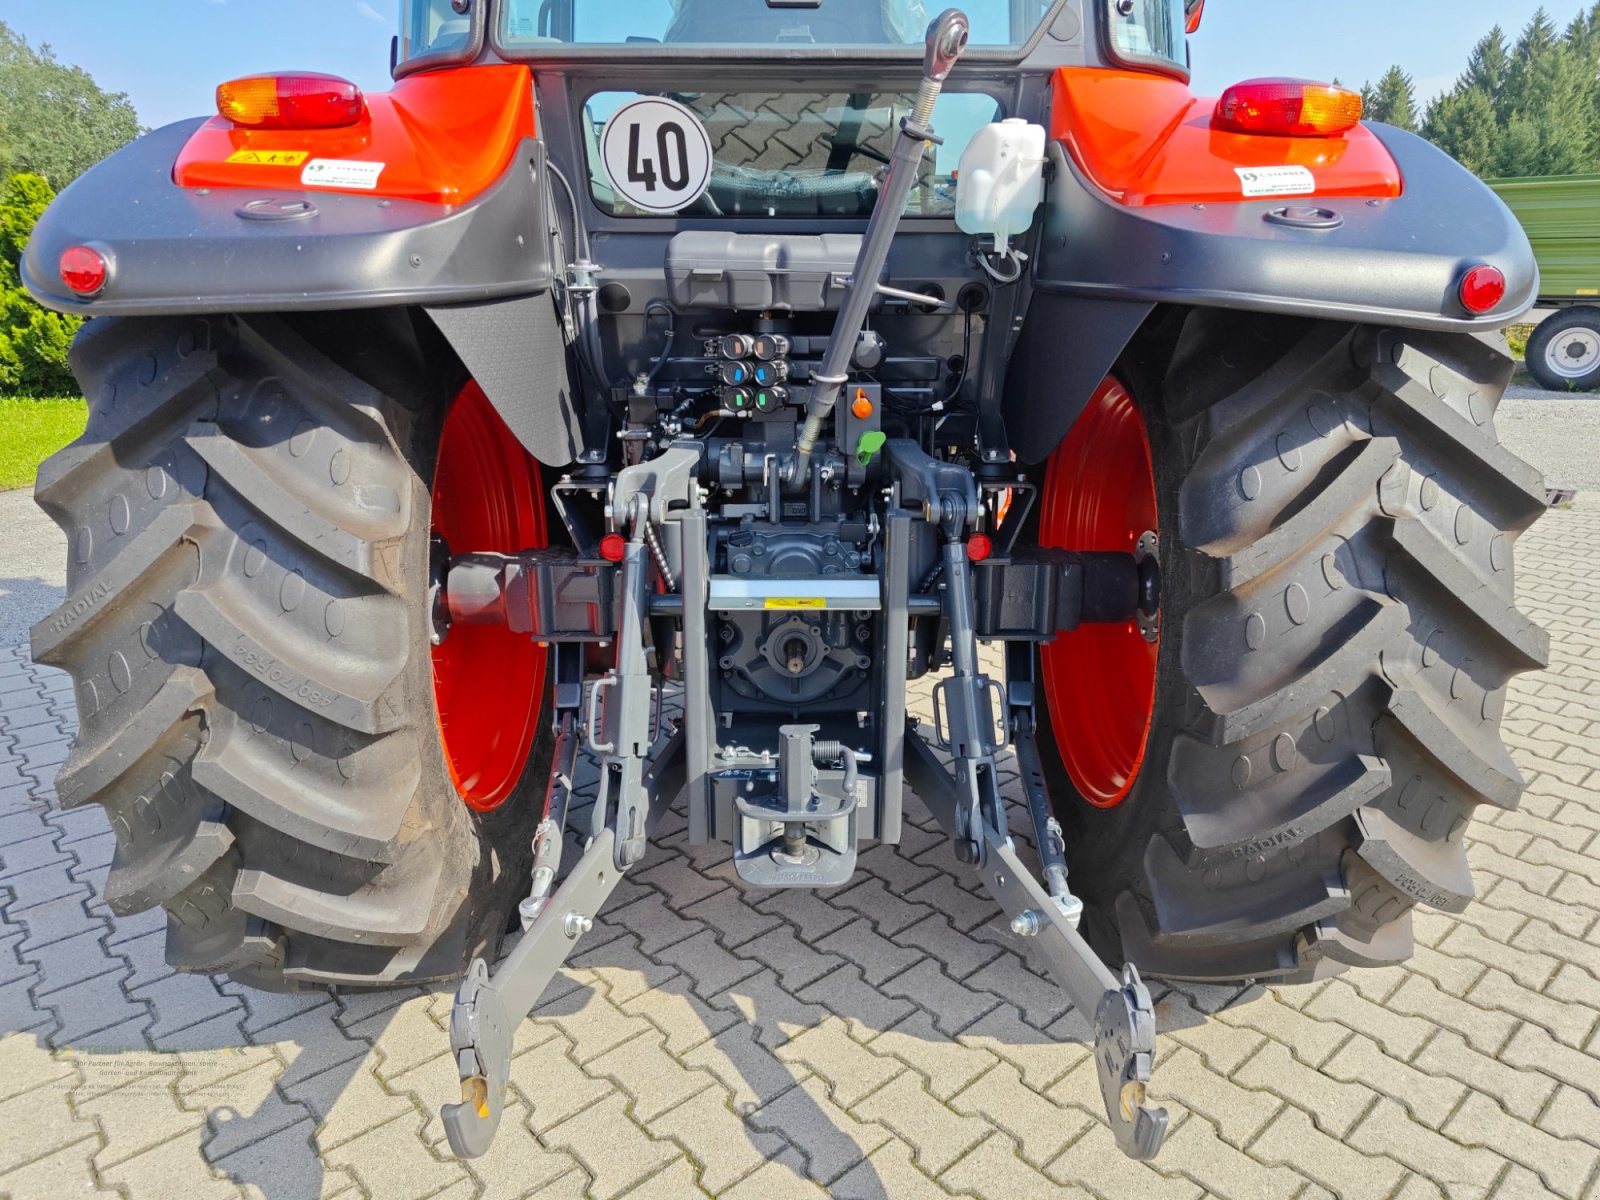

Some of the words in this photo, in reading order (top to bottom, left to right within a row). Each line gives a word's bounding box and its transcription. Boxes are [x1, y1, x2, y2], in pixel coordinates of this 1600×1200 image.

[627, 121, 690, 192] 40
[51, 581, 115, 634] RADIAL
[1231, 826, 1306, 858] RADIAL
